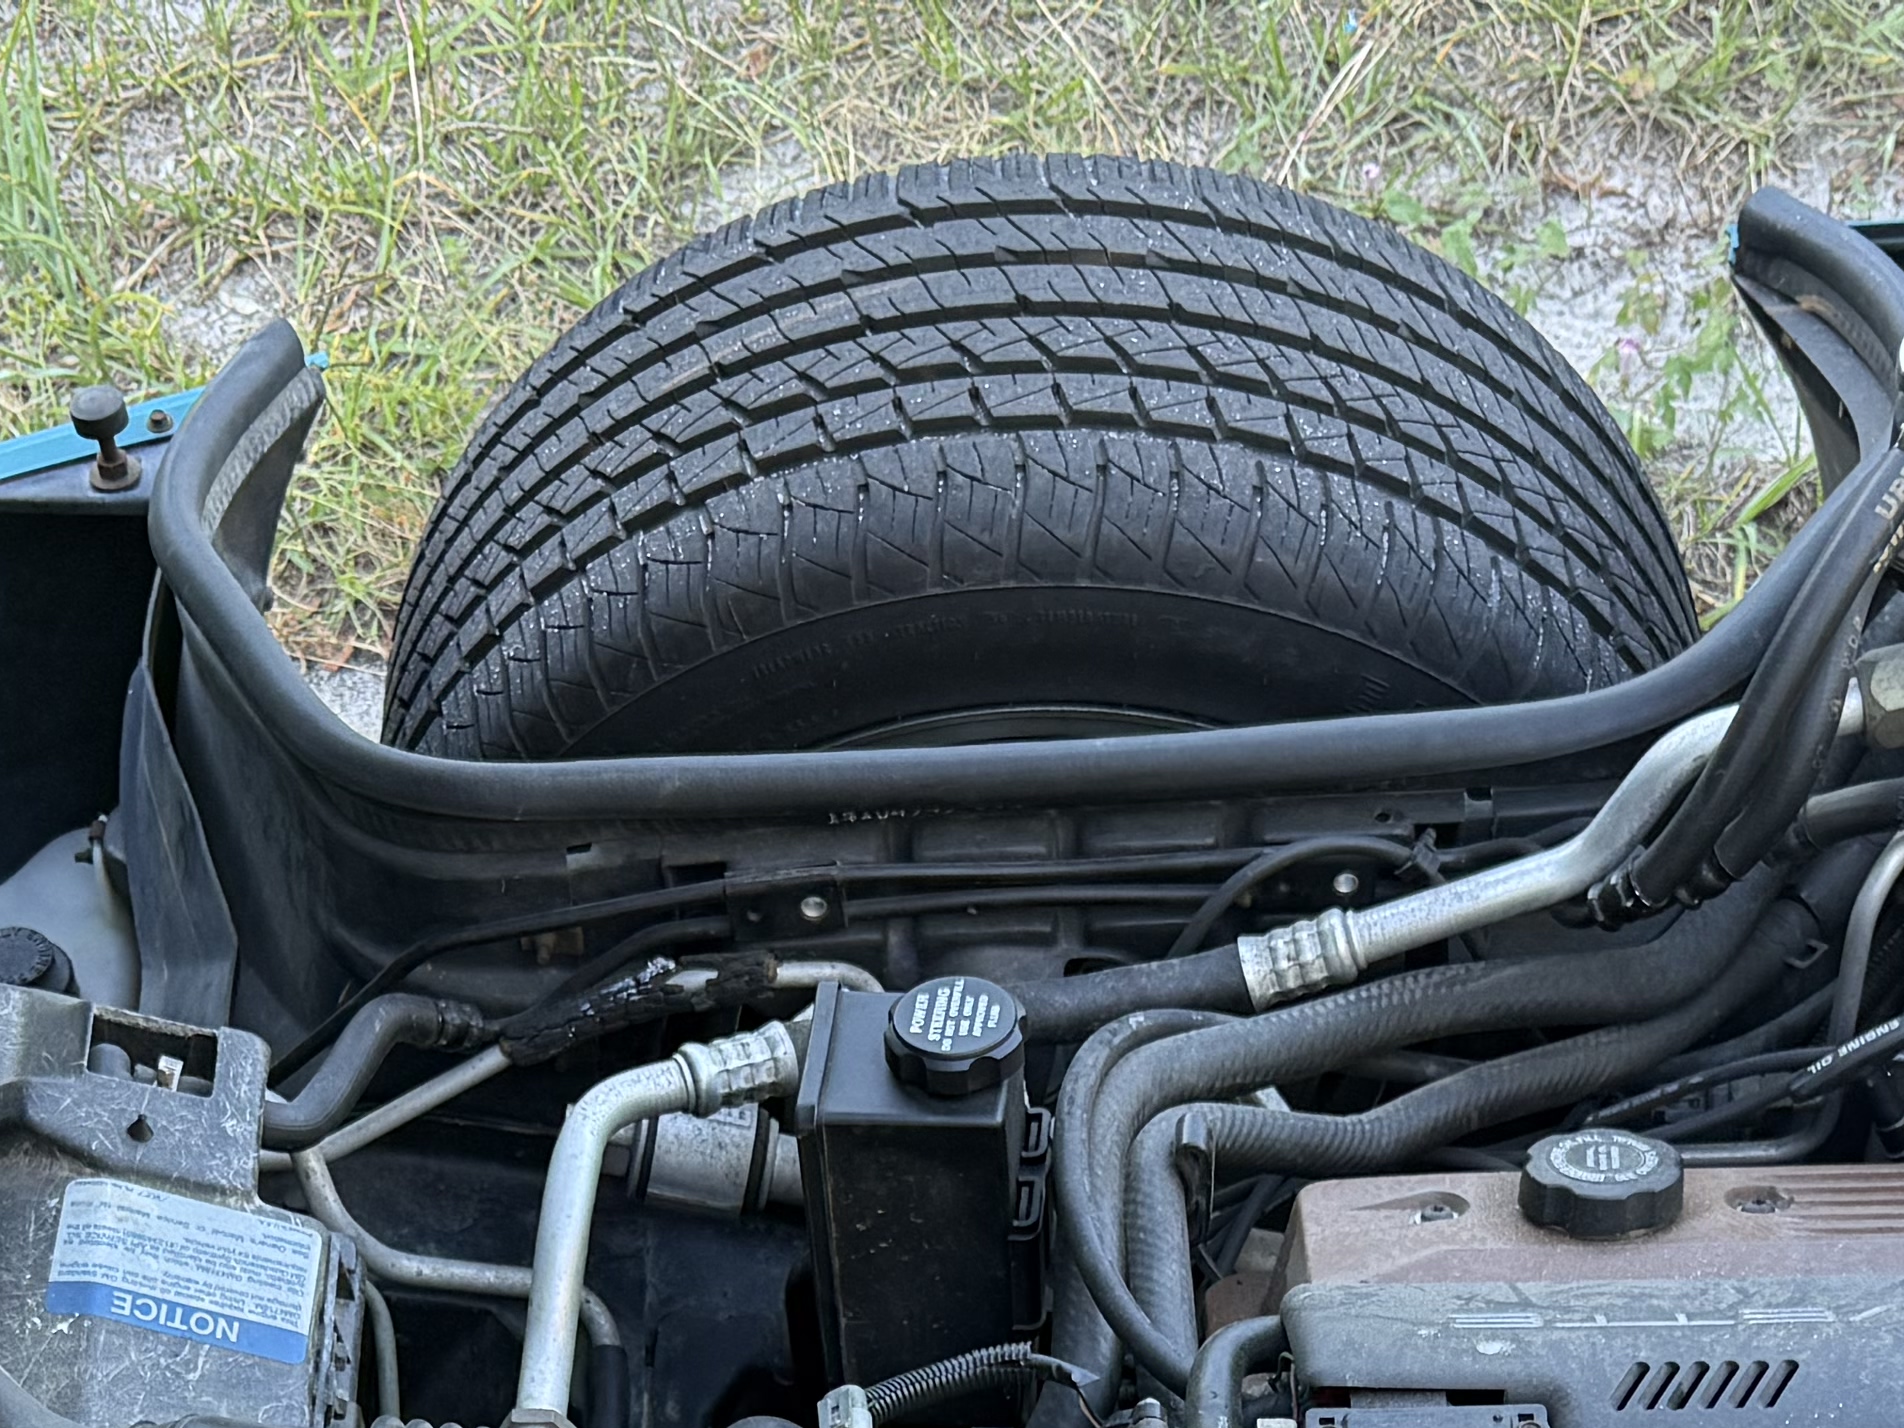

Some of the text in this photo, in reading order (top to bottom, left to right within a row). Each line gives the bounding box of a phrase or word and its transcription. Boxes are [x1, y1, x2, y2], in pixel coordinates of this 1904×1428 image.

[909, 992, 930, 1033] POWER
[926, 986, 951, 1040] STEERING
[1806, 1018, 1902, 1076] ENGINE OIL
[108, 1290, 240, 1342] NOTICE
